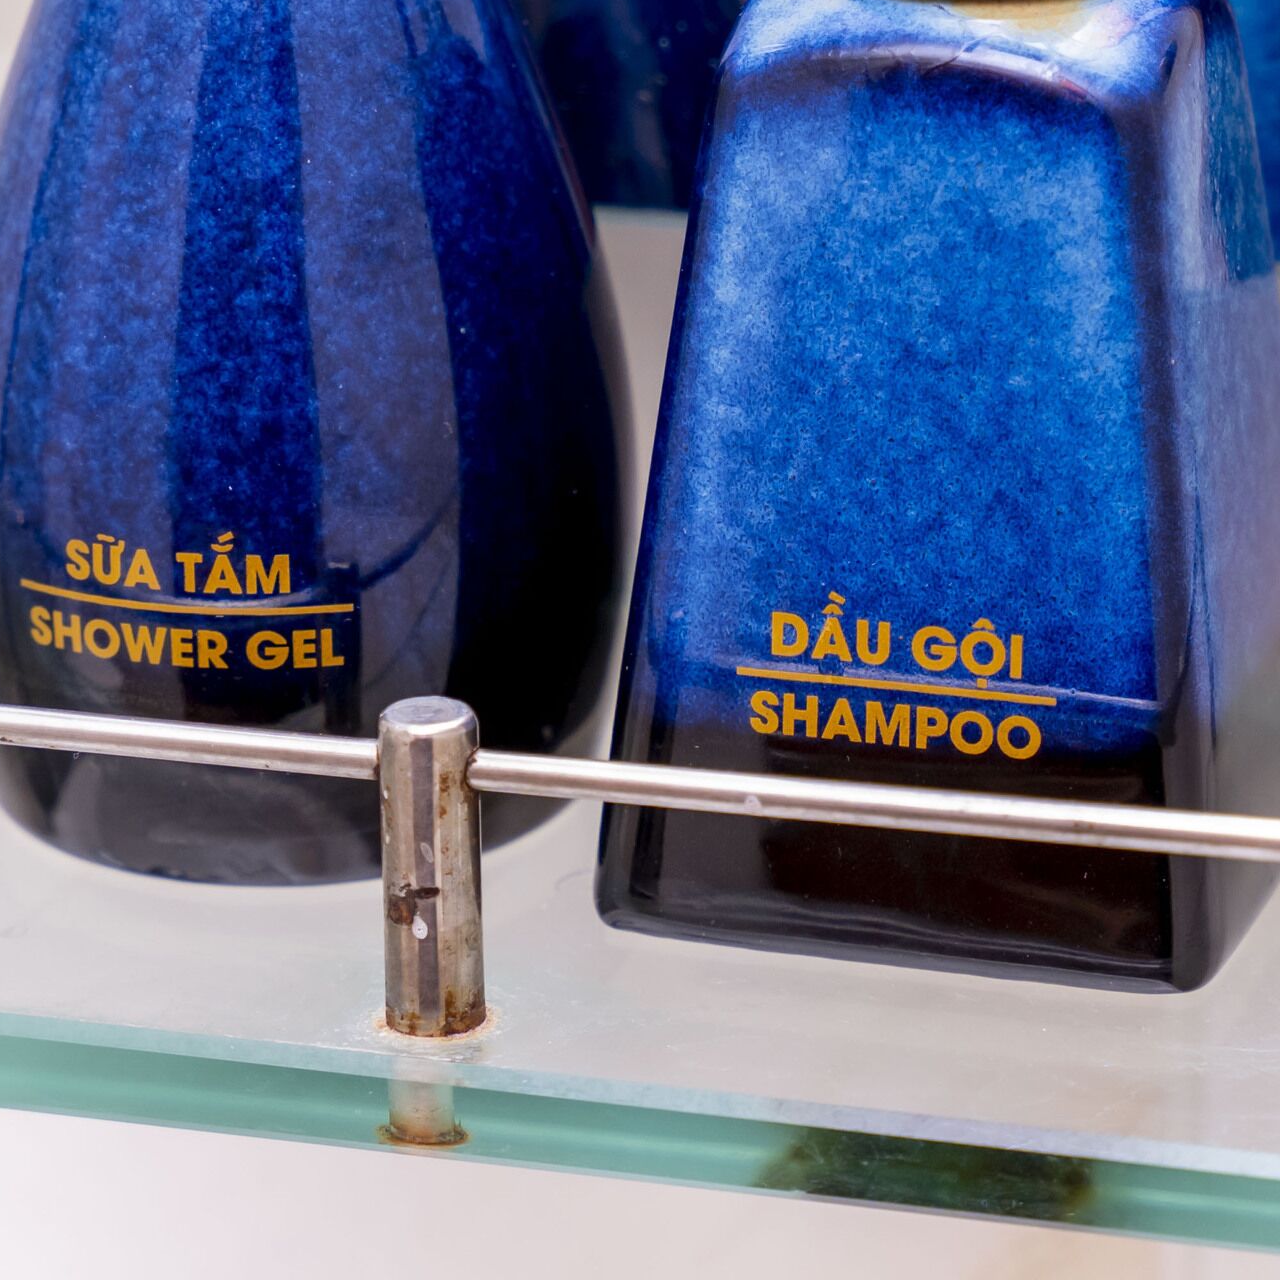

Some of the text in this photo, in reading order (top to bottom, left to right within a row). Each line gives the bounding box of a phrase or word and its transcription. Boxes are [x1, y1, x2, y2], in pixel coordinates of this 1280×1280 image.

[65, 531, 291, 595] SỮA TẮM
[30, 606, 345, 670] SHOWER GEL
[771, 591, 1024, 689] DẦU GỘI
[749, 690, 1042, 760] SHAMPOO
